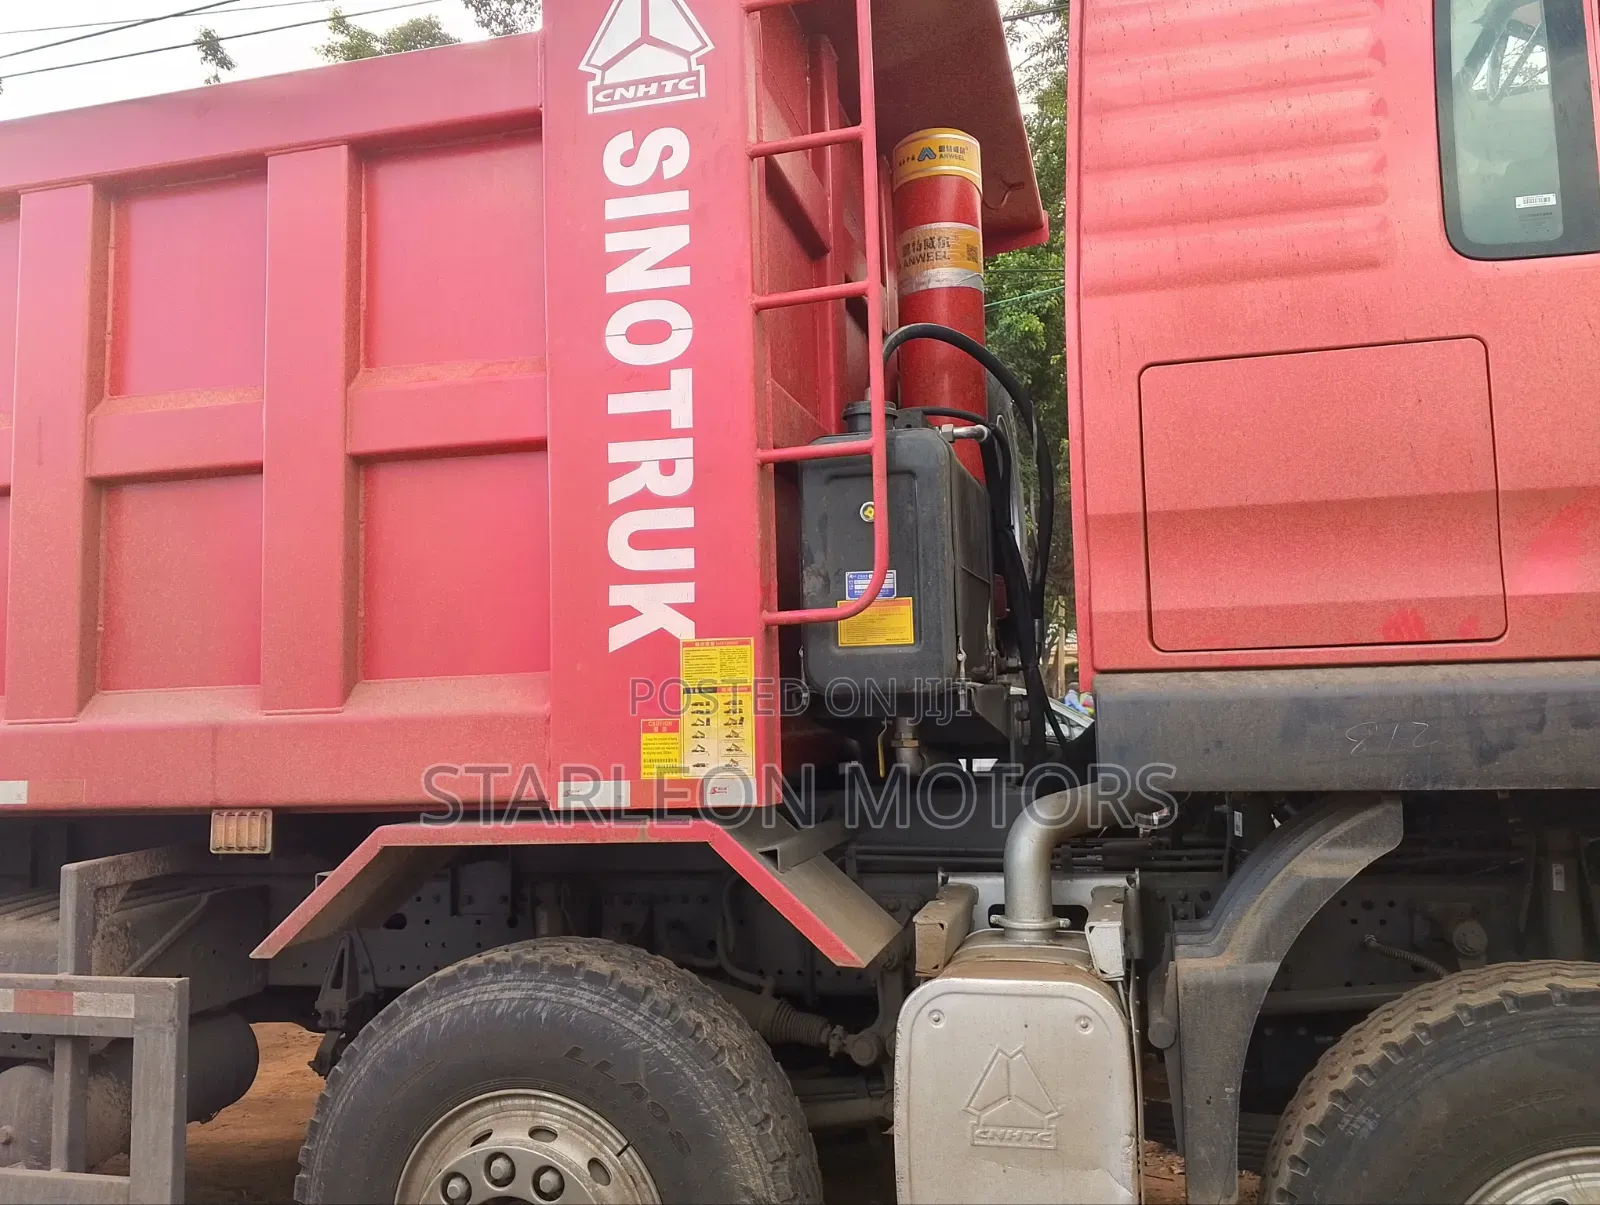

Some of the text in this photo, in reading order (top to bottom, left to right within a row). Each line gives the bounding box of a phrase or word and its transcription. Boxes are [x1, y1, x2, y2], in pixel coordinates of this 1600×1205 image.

[595, 76, 697, 102] CNHTC
[902, 250, 951, 269] ANWEEL
[602, 126, 695, 653] SINOTRUK
[974, 1128, 1052, 1143] CNHTC
